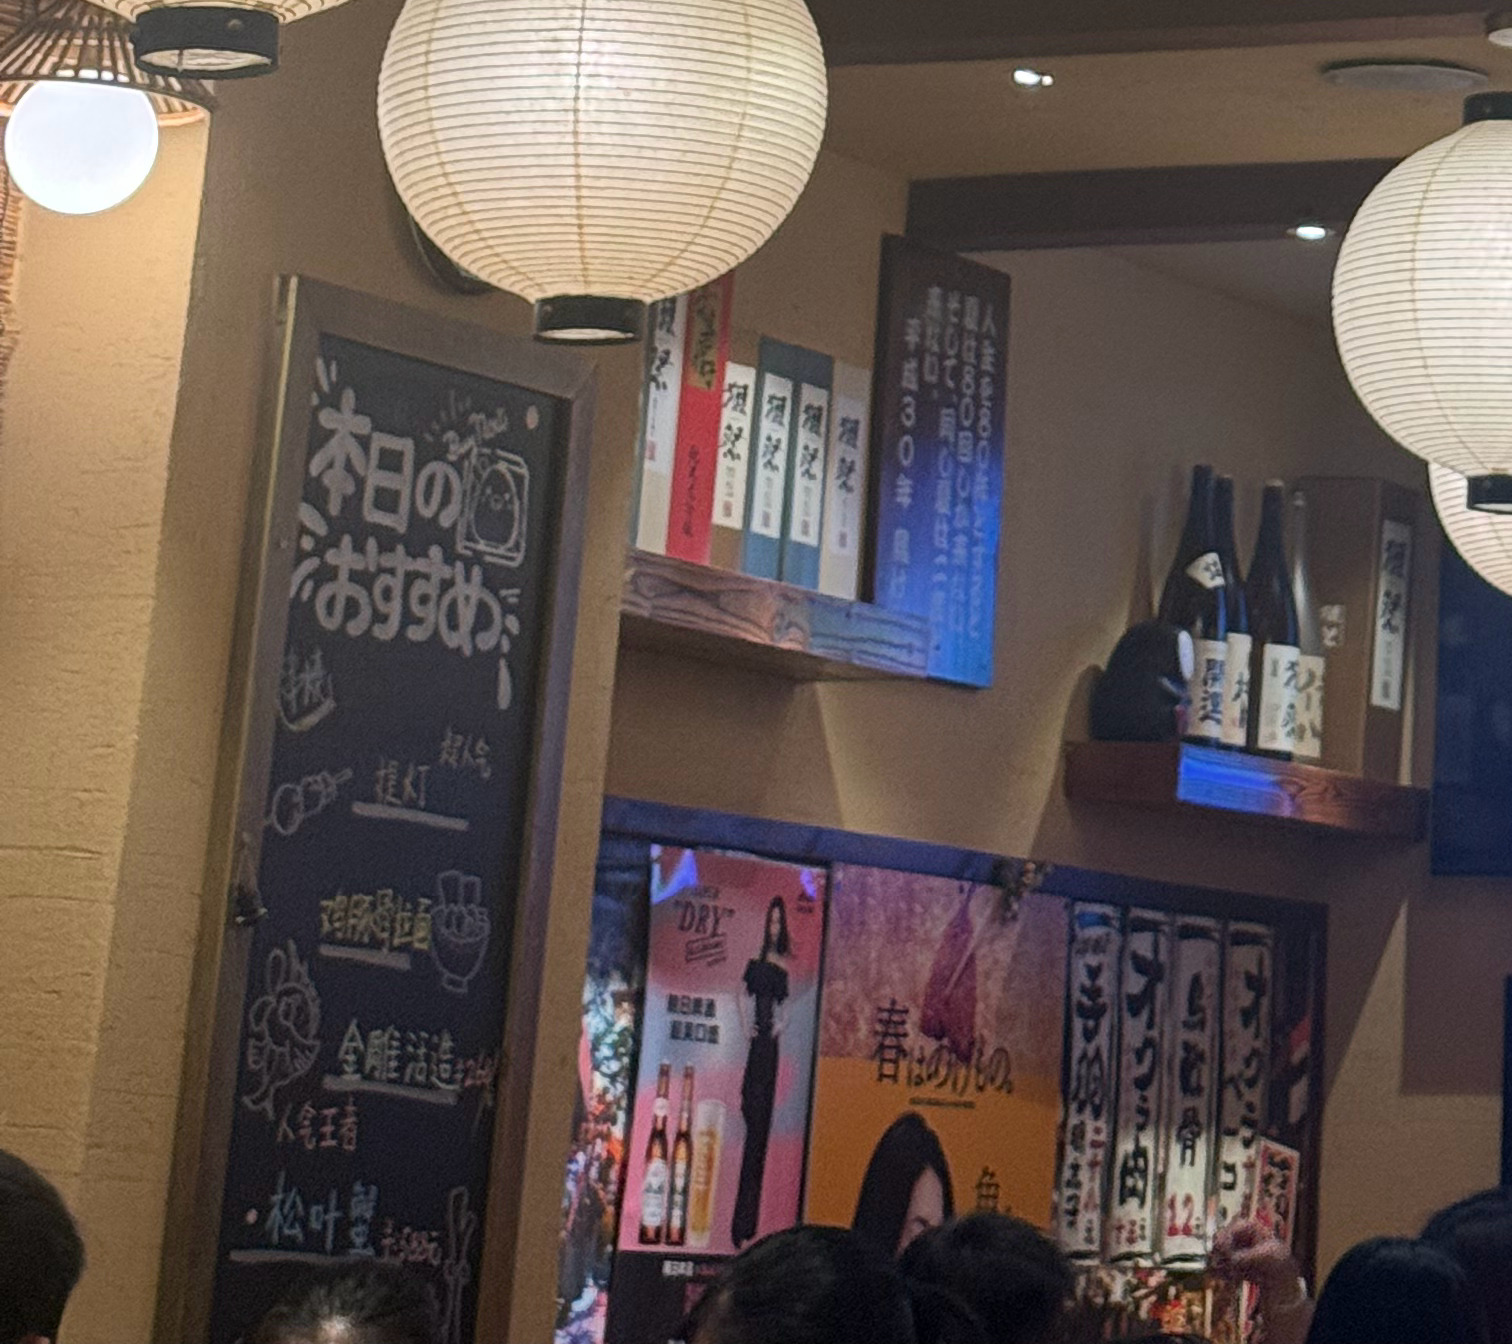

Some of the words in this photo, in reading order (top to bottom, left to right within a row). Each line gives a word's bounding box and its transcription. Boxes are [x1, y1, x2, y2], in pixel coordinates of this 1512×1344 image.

[310, 388, 462, 533] 本日の
[314, 533, 501, 657] おすすめ
